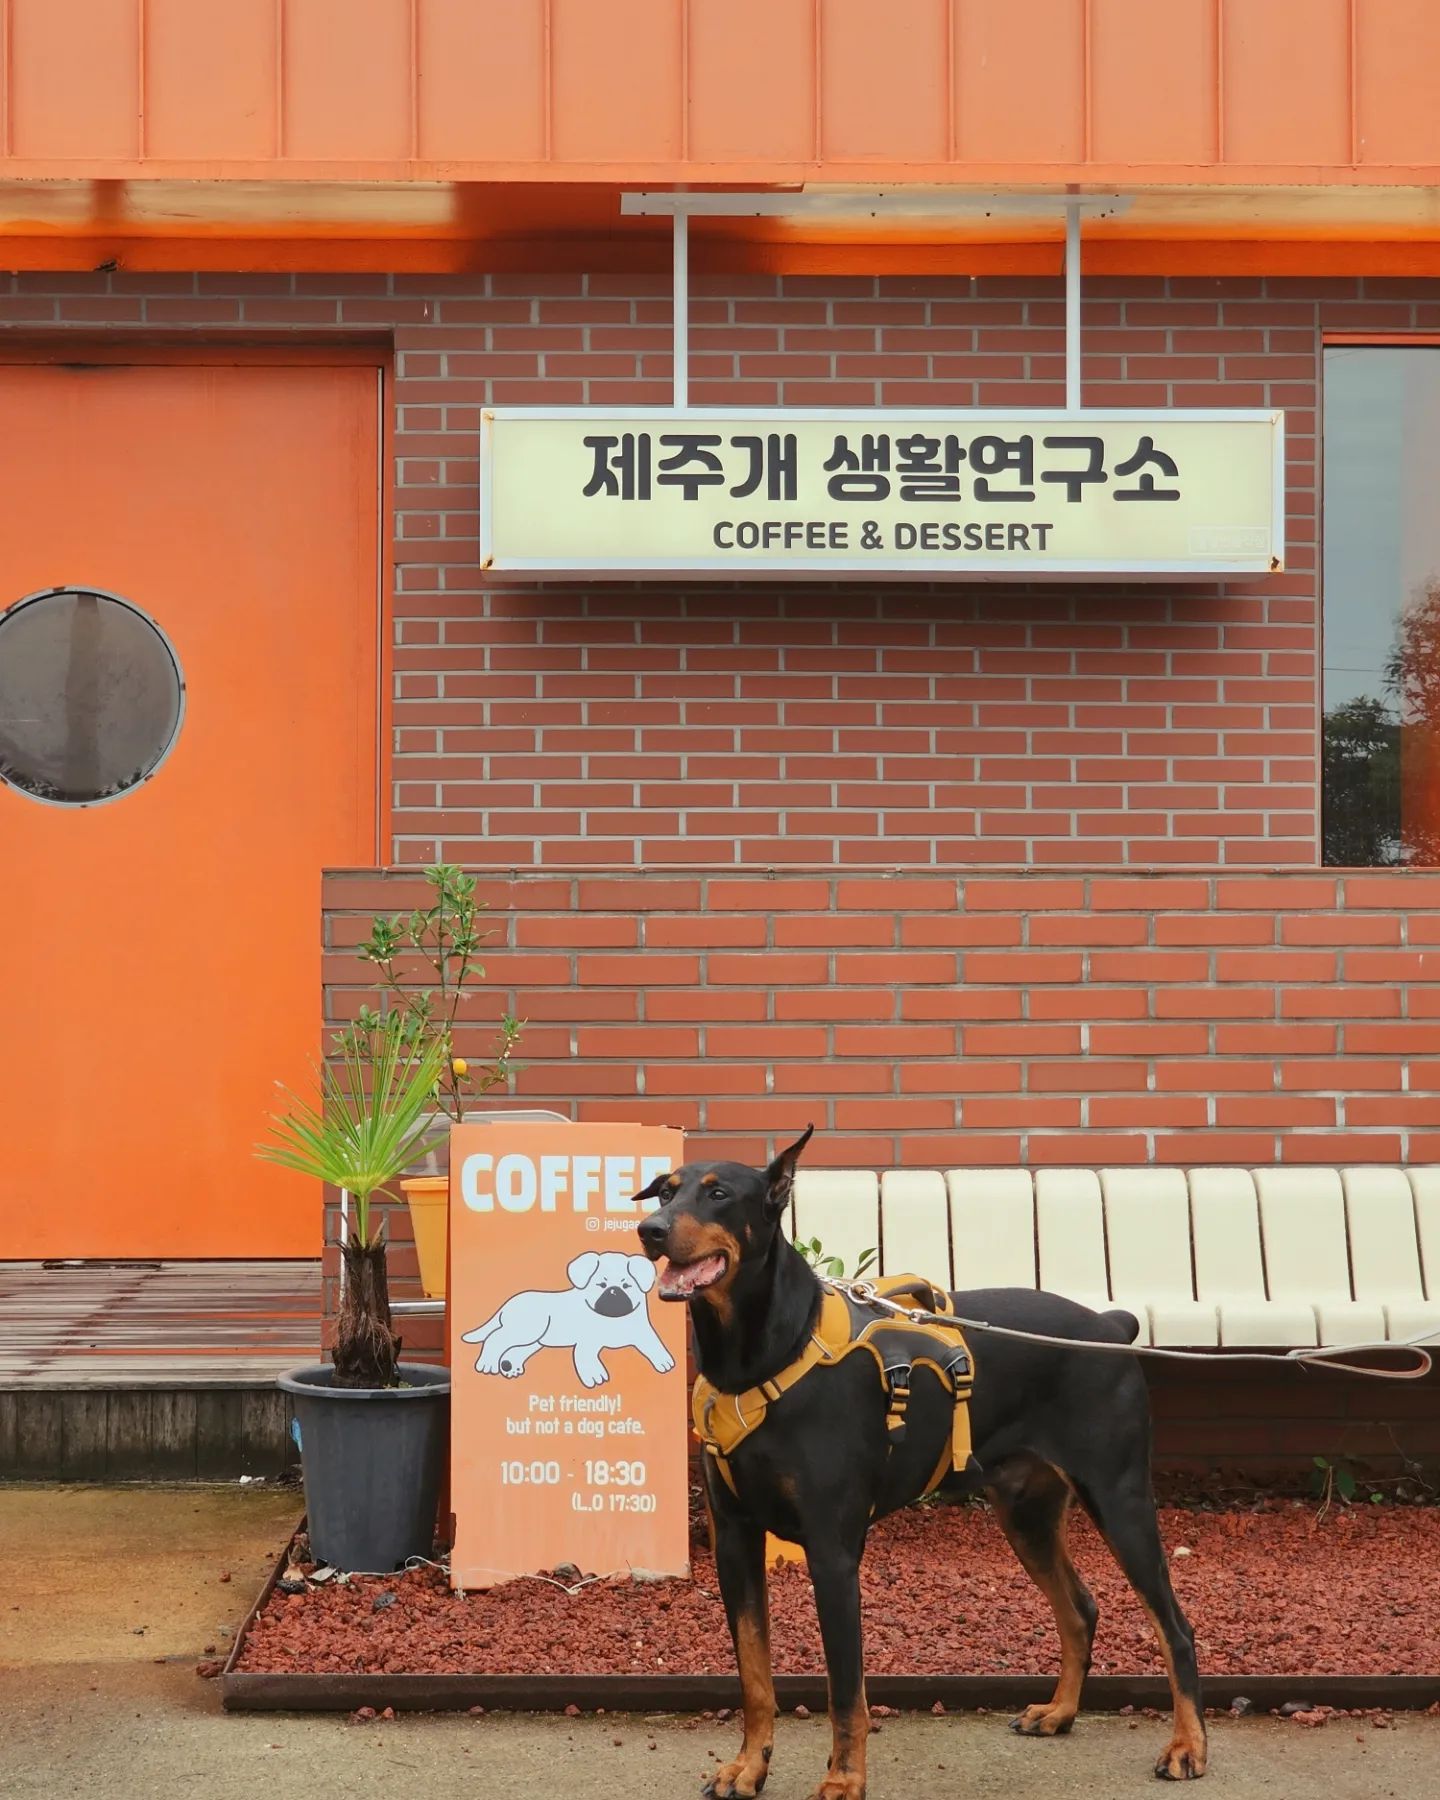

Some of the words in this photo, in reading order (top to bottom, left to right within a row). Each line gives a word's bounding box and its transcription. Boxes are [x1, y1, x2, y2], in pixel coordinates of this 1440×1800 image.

[582, 432, 798, 502] 제주개
[822, 433, 1181, 503] 생활연구소
[713, 521, 849, 550] COFFEE
[860, 520, 884, 550] &
[894, 522, 1054, 551] DESSERT
[528, 1394, 556, 1413] Pet
[559, 1393, 622, 1416] friendly!
[506, 1416, 531, 1435] but
[534, 1417, 560, 1435] not
[563, 1420, 574, 1435] a
[577, 1416, 605, 1439] dog
[607, 1416, 646, 1435] cafe.
[500, 1460, 561, 1485] 10:00
[584, 1460, 646, 1486] 18:30
[608, 1493, 657, 1513] 17:30)
